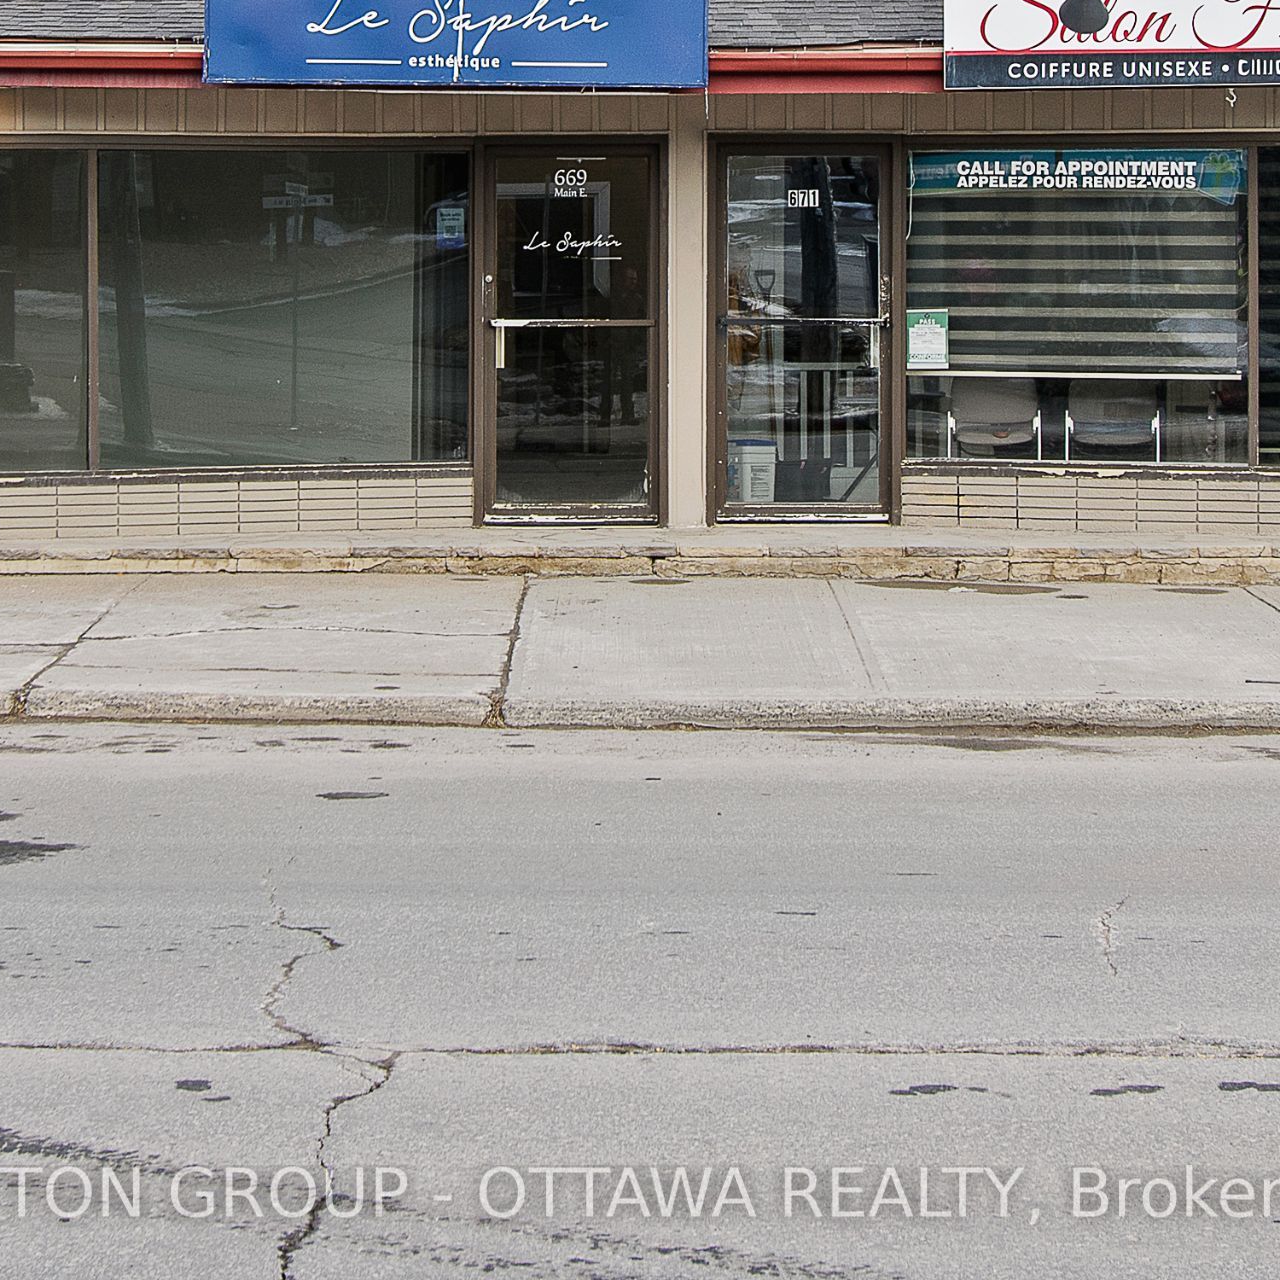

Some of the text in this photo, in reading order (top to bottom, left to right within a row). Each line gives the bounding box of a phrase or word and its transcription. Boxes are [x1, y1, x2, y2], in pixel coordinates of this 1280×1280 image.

[408, 53, 501, 71] esthétique
[1007, 60, 1213, 79] COIFFURE UNISEXE
[956, 160, 1006, 176] CALL
[1011, 160, 1050, 176] FOR
[1054, 160, 1197, 176] APPOINTMENT
[554, 169, 588, 186] 669
[956, 176, 1197, 189] APPELEZ POUR RENDEZ-VOUS
[554, 187, 588, 197] Main E.
[789, 190, 817, 207] 671
[523, 231, 622, 255] Le Saphir
